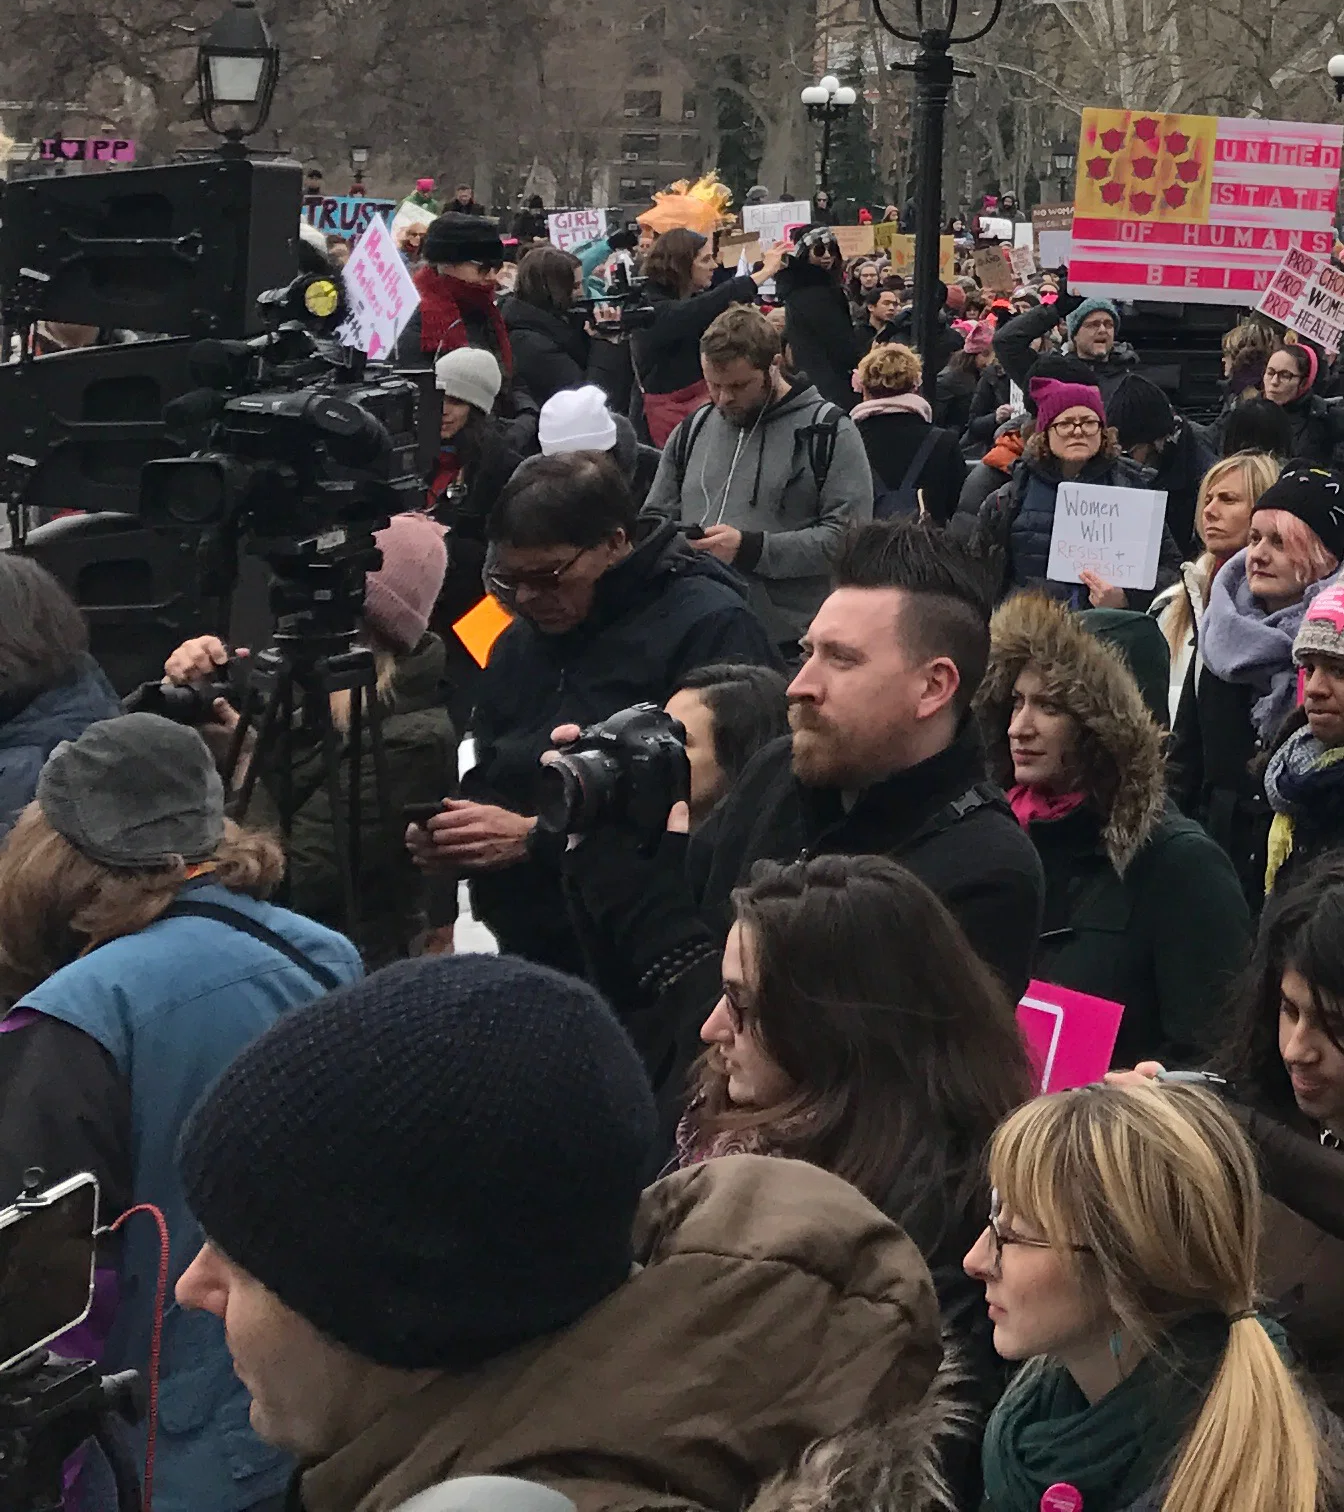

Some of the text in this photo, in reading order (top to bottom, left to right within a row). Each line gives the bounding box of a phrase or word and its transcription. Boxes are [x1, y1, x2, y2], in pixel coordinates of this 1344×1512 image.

[41, 139, 129, 160] I PP
[1222, 142, 1336, 168] UNITED
[1219, 183, 1333, 210] STATE
[302, 196, 396, 233] TRUST
[555, 210, 599, 229] GIRLS
[1033, 209, 1047, 217] NO
[1121, 222, 1328, 252] OF HUMANS
[1063, 490, 1120, 518] Women
[1081, 519, 1113, 544] Will
[1057, 540, 1109, 561] RESIST
[1072, 561, 1135, 577] PERSIST
